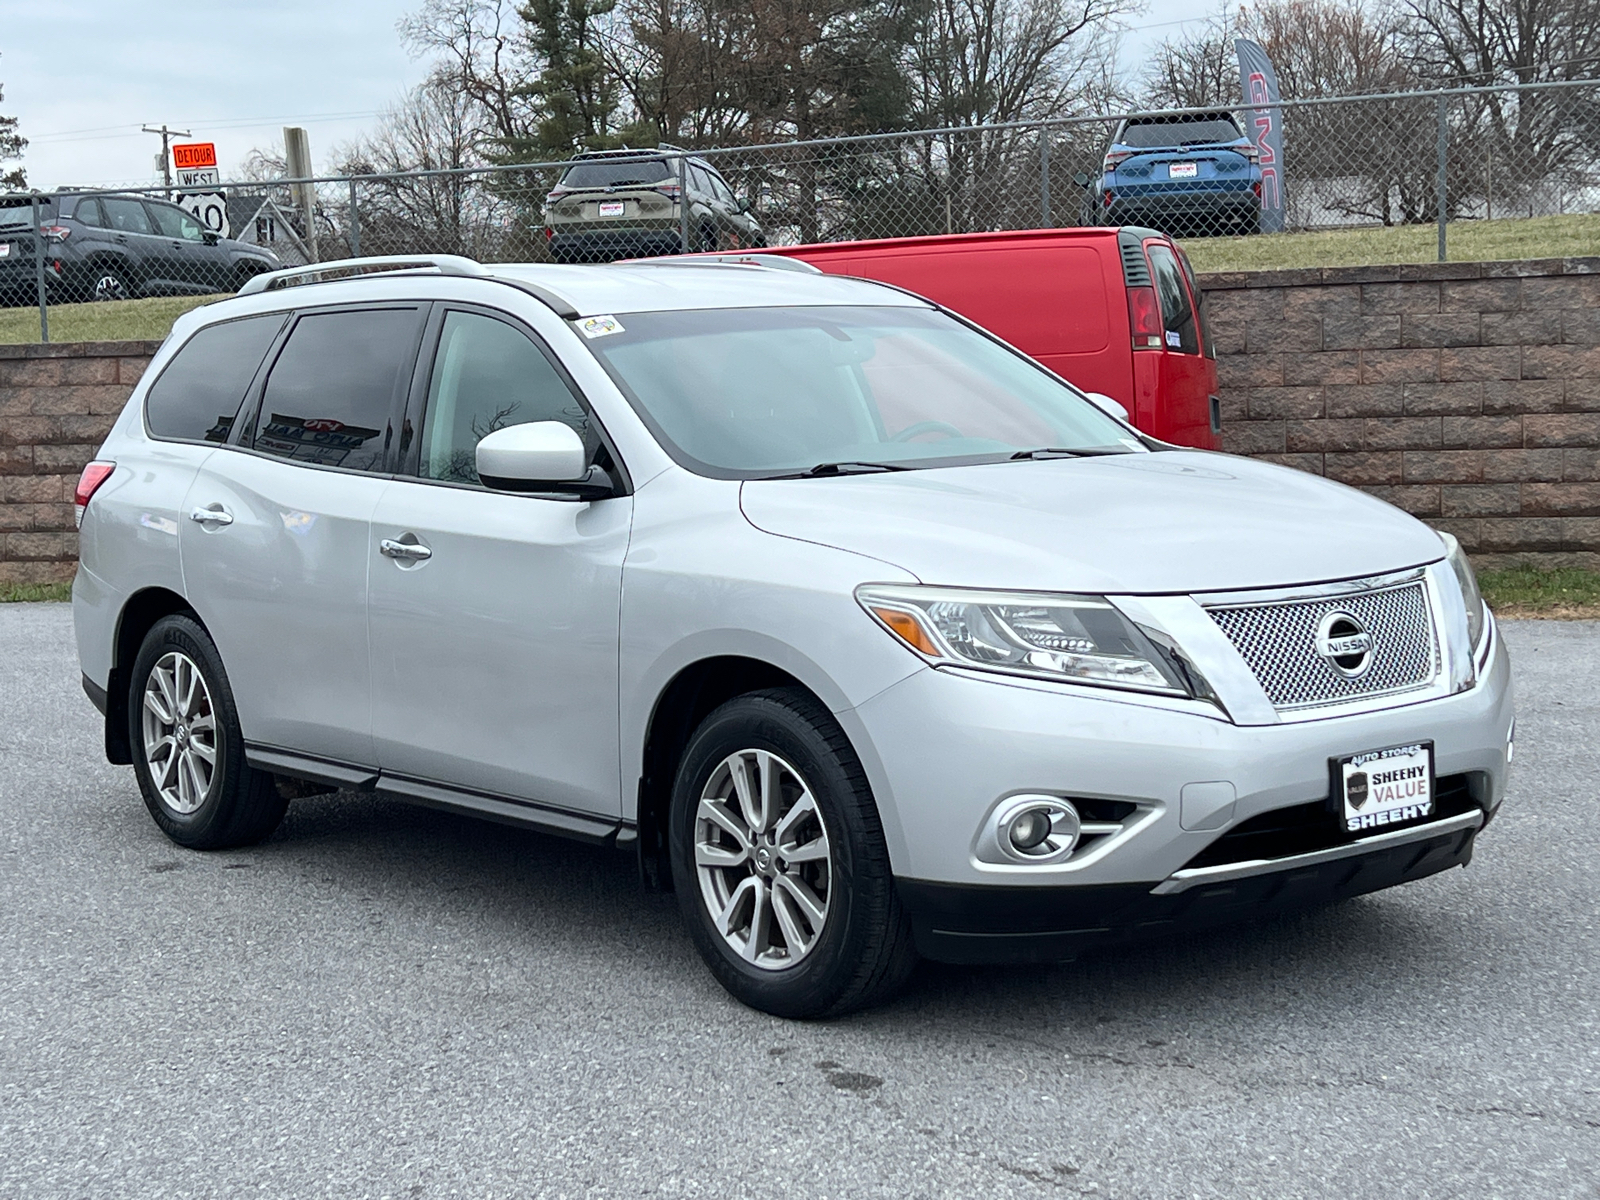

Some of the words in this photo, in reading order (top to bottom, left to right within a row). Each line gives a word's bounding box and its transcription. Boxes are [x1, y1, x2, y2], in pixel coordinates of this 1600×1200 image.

[1249, 72, 1279, 209] GMC
[176, 148, 213, 163] DETOUR
[182, 172, 213, 186] WEST
[1350, 752, 1379, 765] AUTO
[1380, 744, 1422, 760] STORES
[1372, 765, 1425, 785] SHEEHY
[1373, 779, 1427, 803] VALUE
[1347, 802, 1432, 831] SHEEHY
